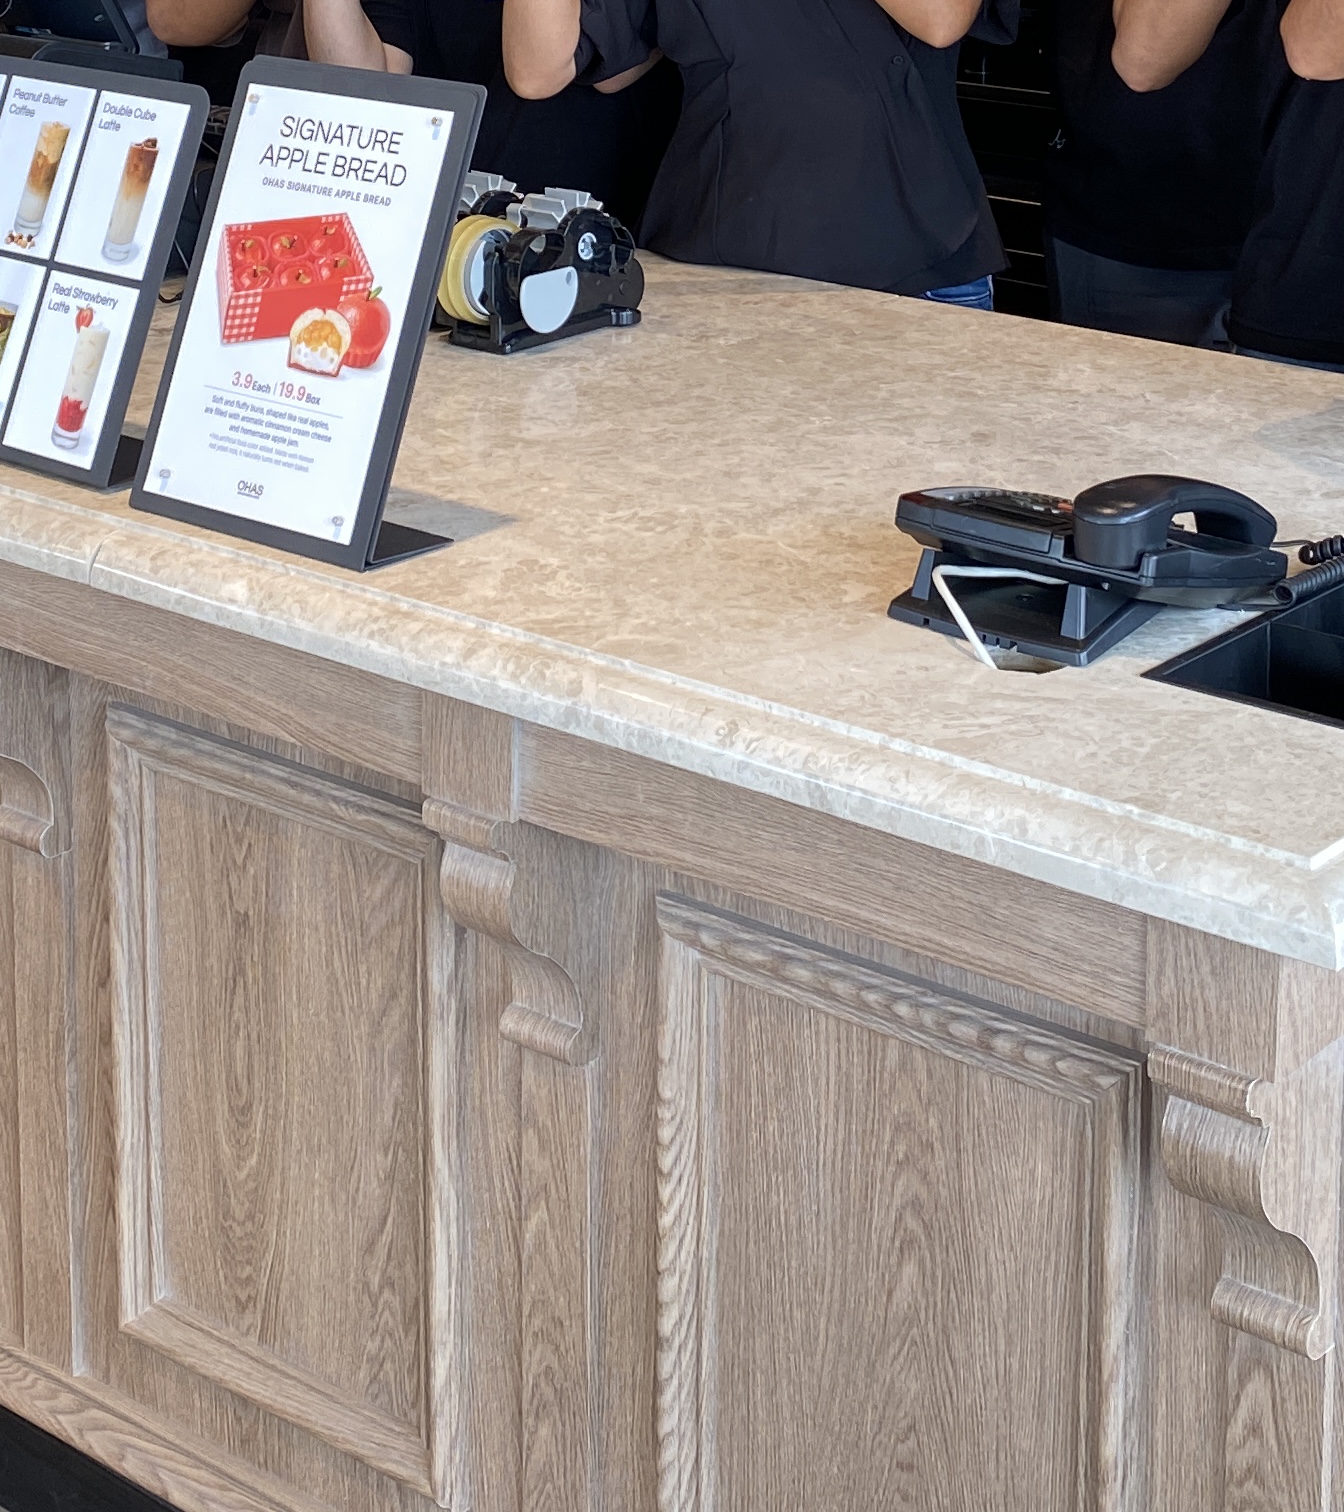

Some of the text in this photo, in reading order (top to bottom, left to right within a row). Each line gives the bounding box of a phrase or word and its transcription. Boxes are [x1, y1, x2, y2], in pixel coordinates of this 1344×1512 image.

[12, 87, 68, 106] Peanut Butter
[8, 102, 35, 117] Coffee
[102, 101, 156, 121] Double Cube
[97, 117, 121, 131] Latte
[279, 115, 403, 154] SIGNATURE
[258, 143, 406, 186] APPLE BREAD
[262, 176, 391, 206] OHAS SIGNATURE APPLE BREAD
[47, 298, 70, 314] Latte
[51, 282, 118, 310] Real Strawberry
[231, 370, 321, 405] 3.9 Each 19.9 Box
[211, 394, 224, 404] Soft
[223, 399, 235, 407] and
[234, 399, 250, 412] fluffy
[265, 408, 287, 419] shaped
[286, 412, 297, 422] like
[296, 416, 309, 424] real
[203, 406, 213, 414] are
[213, 406, 228, 417] filled
[227, 412, 240, 420] with
[264, 420, 292, 433] cinnamon
[291, 427, 310, 437] cream
[310, 431, 332, 442] cheese
[228, 424, 240, 433] and
[239, 425, 271, 440] homemade
[270, 434, 287, 444] apple
[237, 479, 264, 496] OHAS
